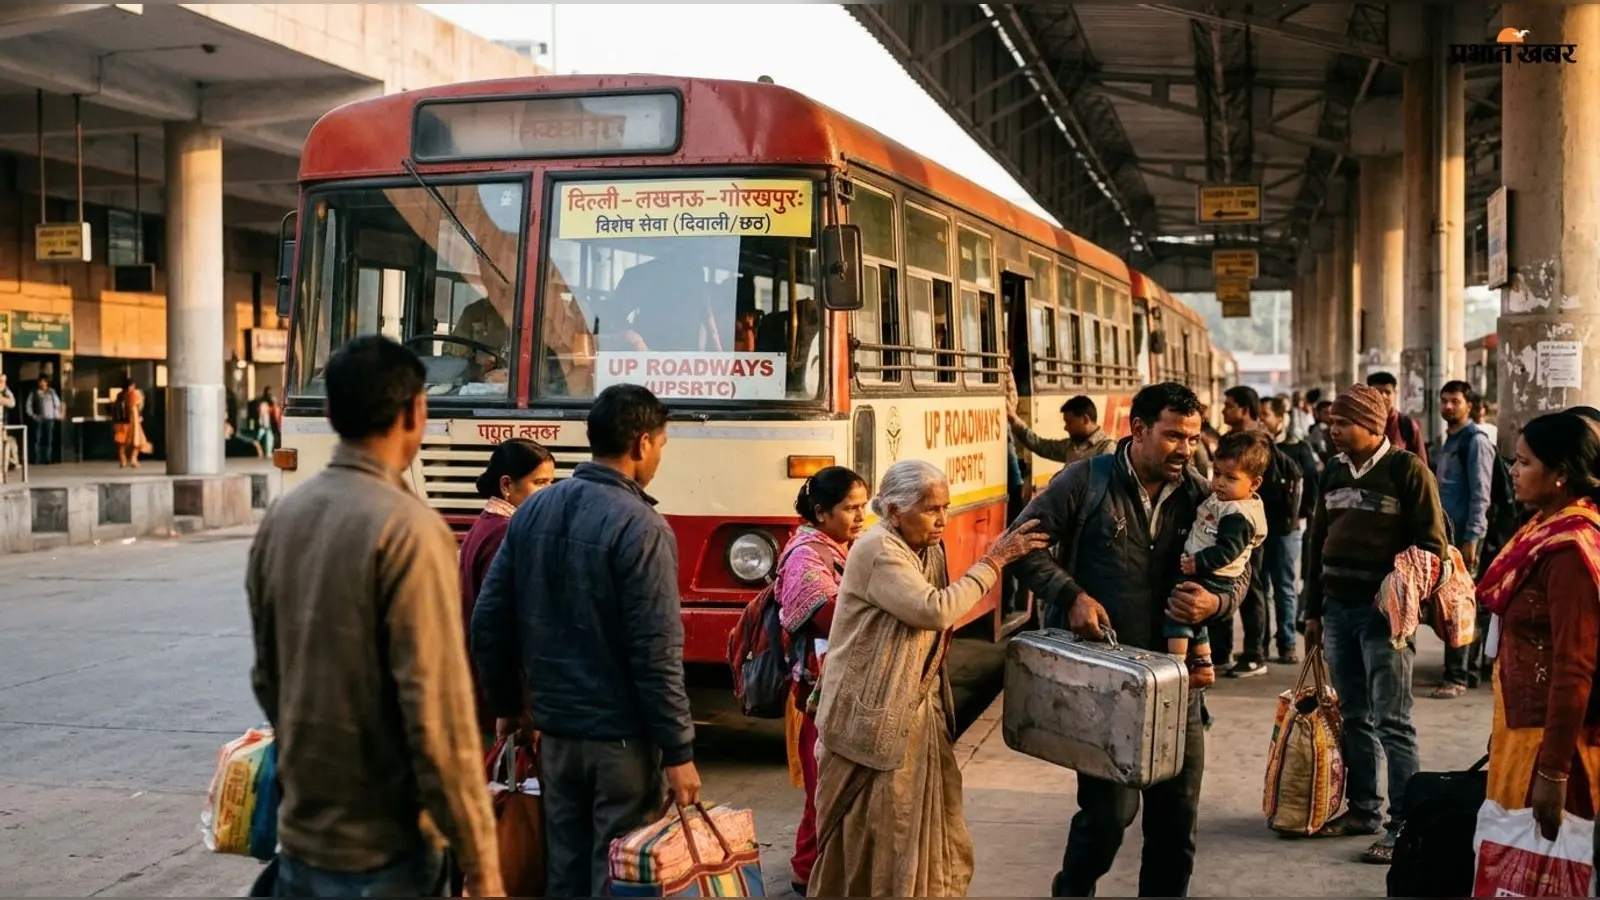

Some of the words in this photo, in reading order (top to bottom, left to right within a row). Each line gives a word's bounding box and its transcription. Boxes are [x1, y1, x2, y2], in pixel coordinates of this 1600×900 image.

[596, 213, 635, 234] विशेष
[639, 213, 668, 232] सेवा
[608, 358, 638, 376] UP
[646, 358, 774, 377] ROADWAYS
[924, 410, 941, 450] UP
[945, 407, 1001, 447] ROADWAYS
